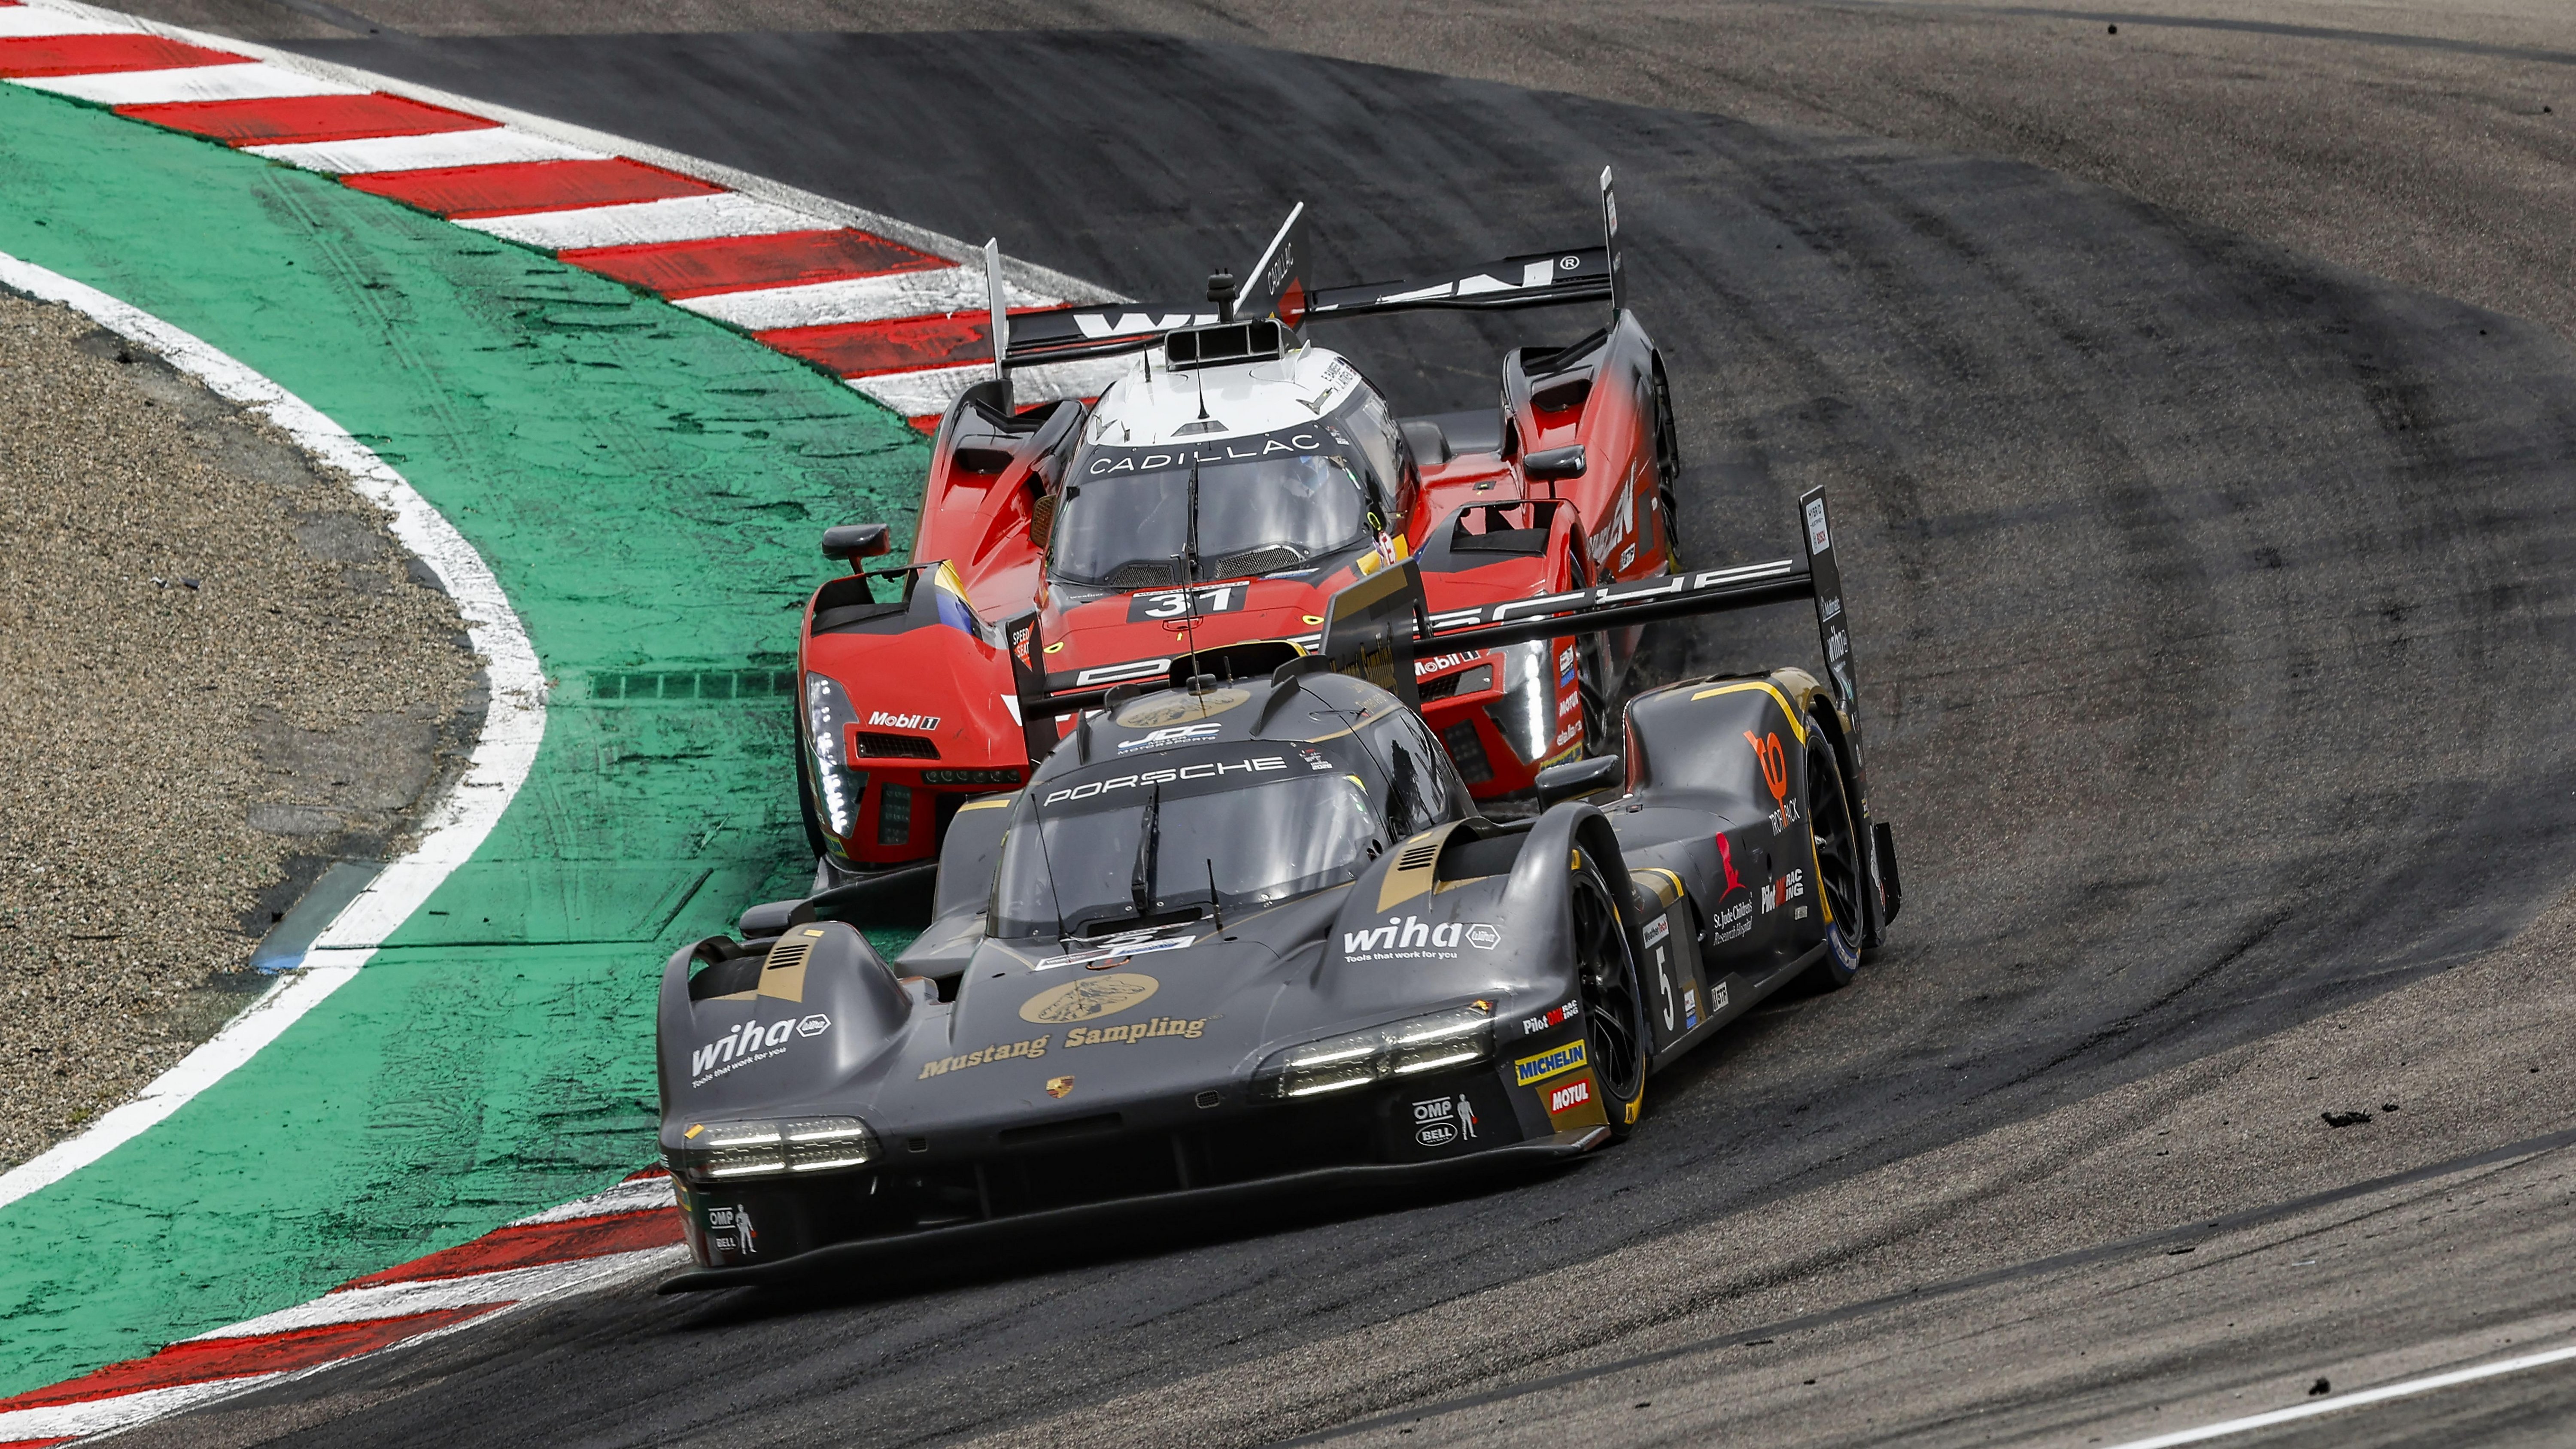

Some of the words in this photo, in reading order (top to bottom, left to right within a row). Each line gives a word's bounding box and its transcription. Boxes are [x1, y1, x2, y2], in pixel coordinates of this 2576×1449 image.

[1268, 242, 1294, 296] CADILLAC
[1089, 434, 1320, 474] CADILLAC
[1145, 588, 1231, 617] 31
[1013, 628, 1029, 645] SPEED
[1827, 625, 1844, 662] wiha
[1017, 641, 1029, 658] SEAT
[869, 711, 921, 728] Mobil
[1043, 756, 1287, 806] PORSCHE
[1721, 908, 1733, 930] Jude
[1344, 915, 1463, 954] wiha
[1345, 954, 1372, 963] Tools
[1395, 951, 1421, 959] work
[1422, 950, 1436, 958] for
[1656, 946, 1674, 1031] 5
[1561, 999, 1578, 1013] RAC
[1563, 1007, 1579, 1020] ING
[1522, 1015, 1549, 1035] Pilot
[692, 1018, 796, 1078] wiha
[917, 1034, 1051, 1081] Mustang
[1062, 1016, 1209, 1049] Sampling
[692, 1073, 713, 1089] Tools
[714, 1065, 731, 1078] that
[732, 1056, 753, 1069] work
[753, 1052, 768, 1062] for
[769, 1047, 787, 1058] you
[1519, 1045, 1584, 1080] MICHELIN
[1552, 1082, 1589, 1111] MOTUL
[1414, 1101, 1452, 1120] OMP
[1422, 1127, 1452, 1141] BELL
[710, 1211, 733, 1225] OMP
[716, 1237, 736, 1247] BELL
